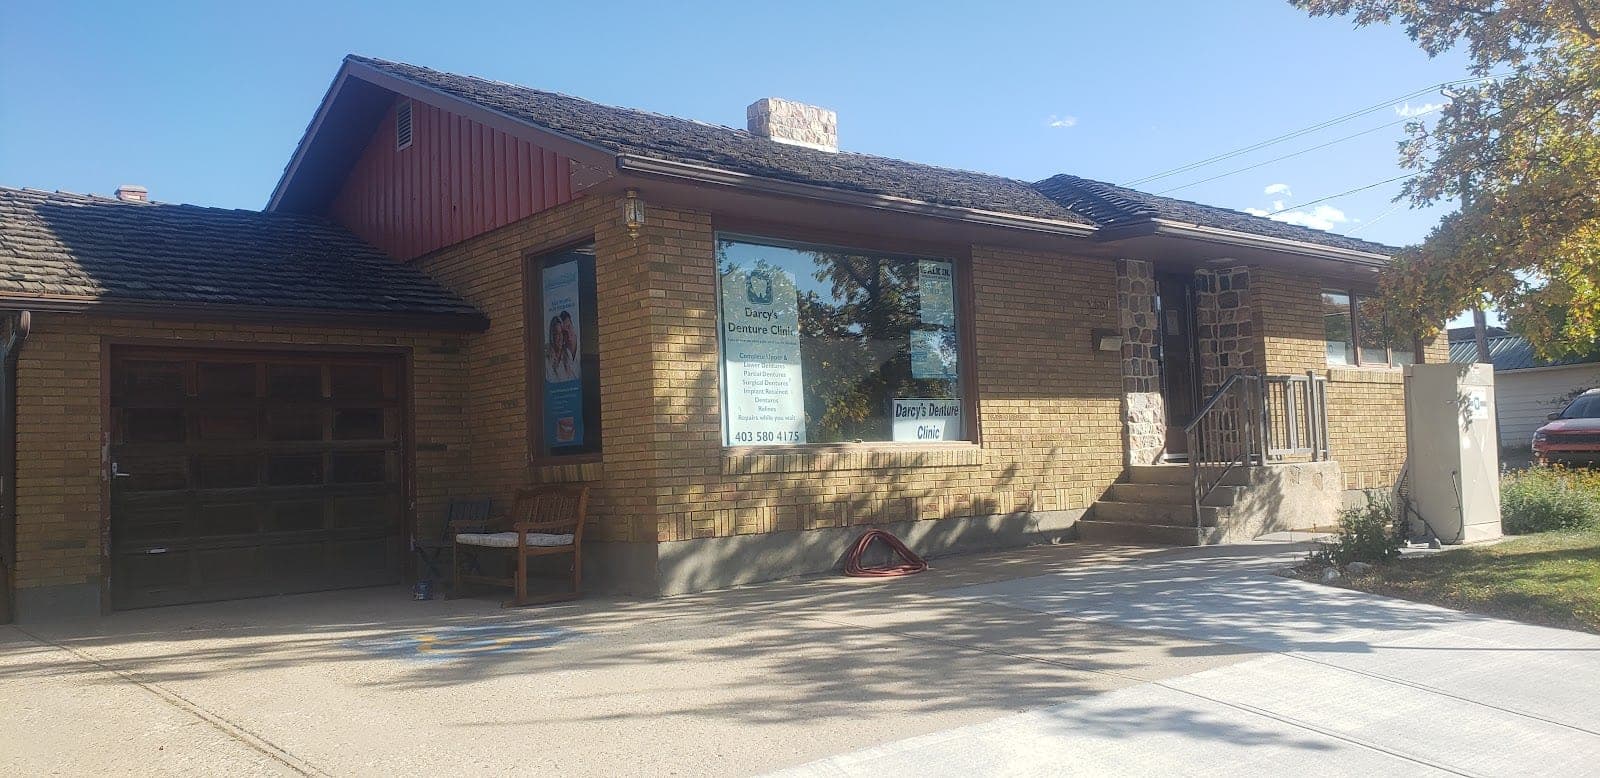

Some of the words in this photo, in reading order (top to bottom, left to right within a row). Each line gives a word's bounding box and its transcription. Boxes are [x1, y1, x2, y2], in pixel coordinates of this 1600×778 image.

[745, 307, 778, 321] Darcy's
[728, 322, 767, 334] Denture
[742, 379, 763, 387] Surgical
[764, 379, 789, 387] Dentures
[895, 402, 927, 420] Darcy's
[928, 402, 959, 417] Denture
[735, 431, 753, 442] 403
[756, 431, 774, 442] 580
[776, 431, 800, 442] 4175
[917, 425, 940, 440] Clinic
